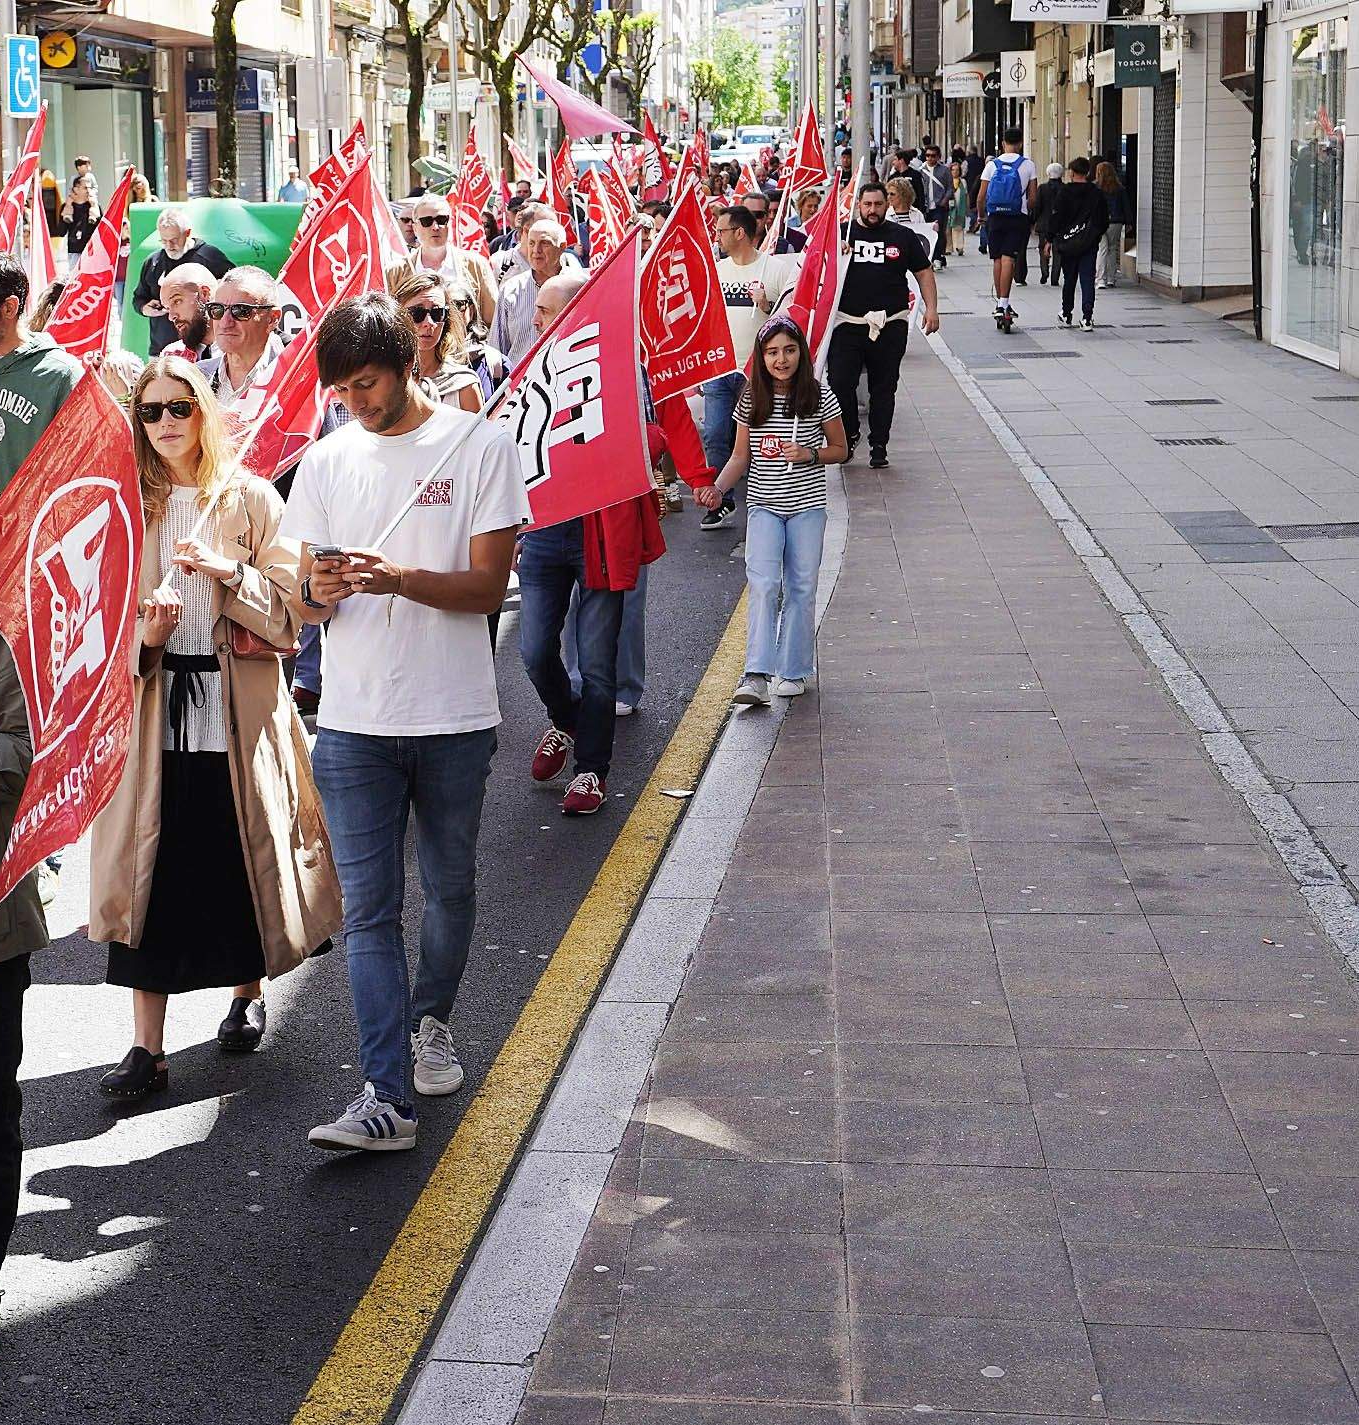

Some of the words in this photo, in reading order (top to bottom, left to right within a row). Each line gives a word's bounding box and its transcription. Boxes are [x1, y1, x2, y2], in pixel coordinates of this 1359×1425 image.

[198, 76, 251, 93] FRA
[854, 240, 885, 263] DC
[722, 281, 753, 294] BOS
[649, 346, 726, 387] ww.UGT.es
[548, 321, 604, 449] UGT
[762, 437, 781, 450] UGT
[417, 481, 451, 494] EUS
